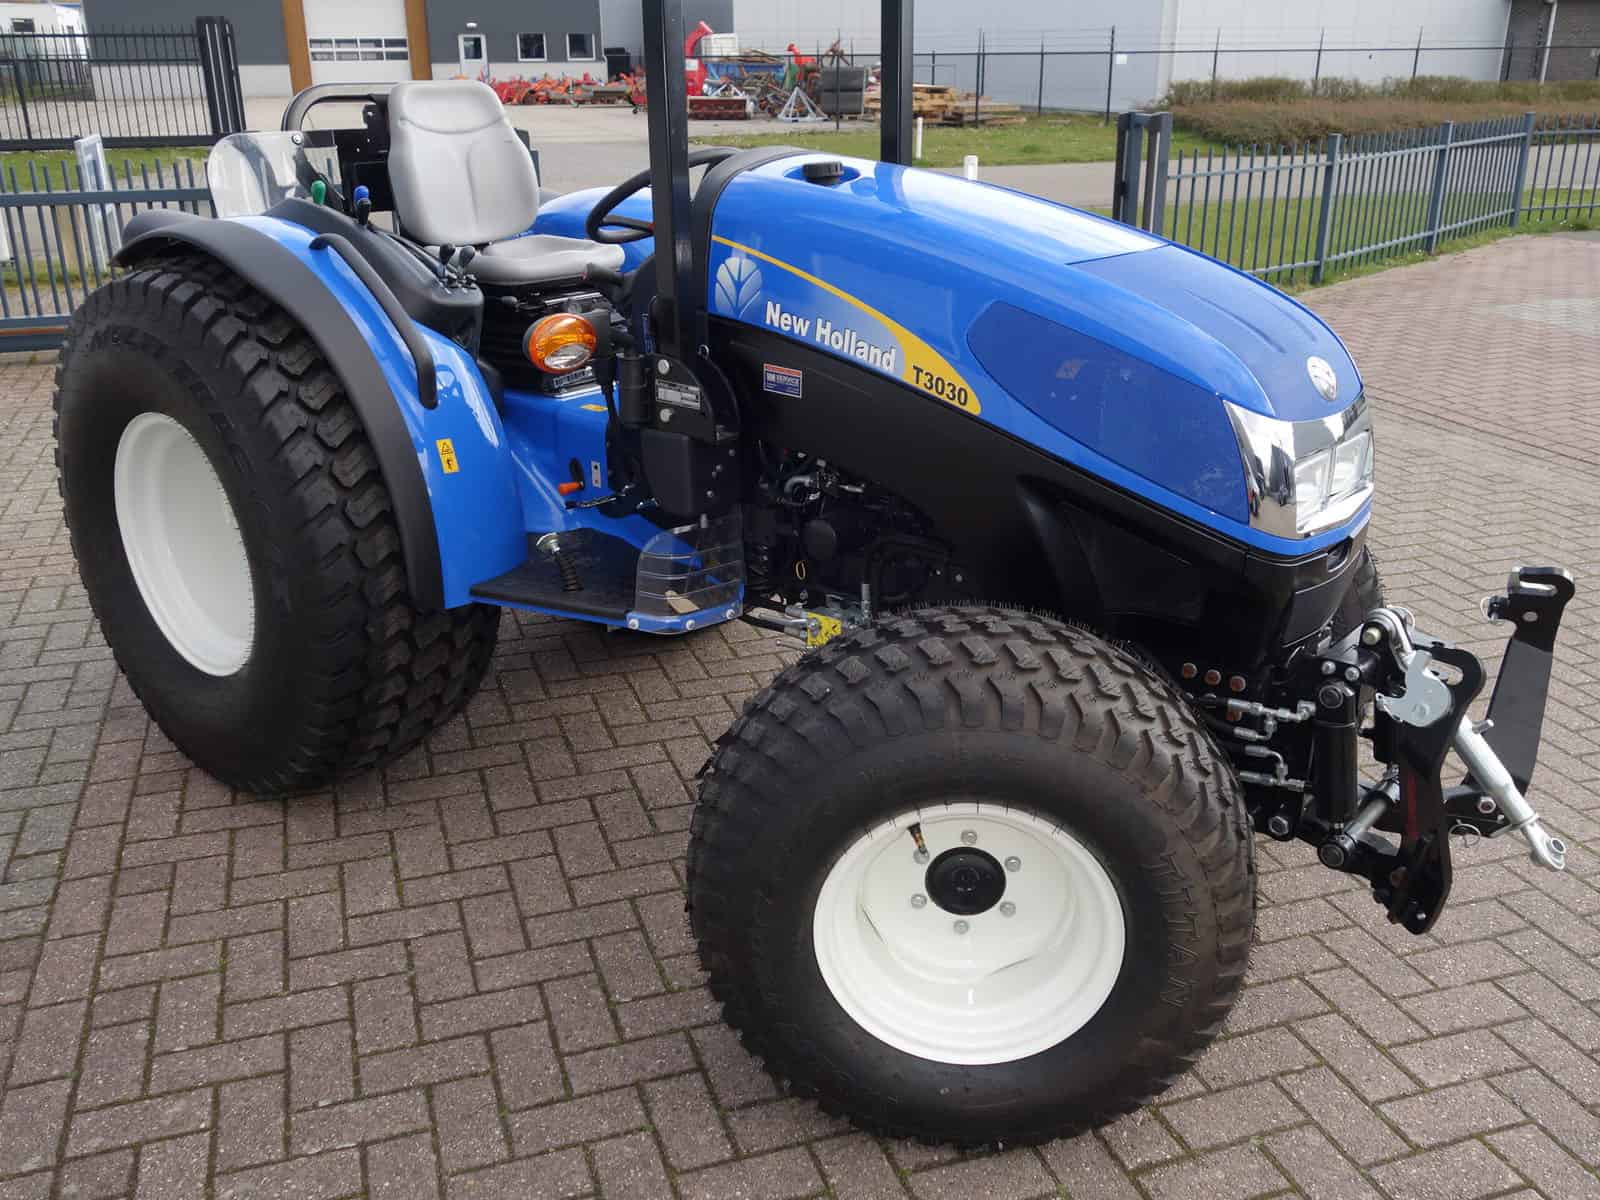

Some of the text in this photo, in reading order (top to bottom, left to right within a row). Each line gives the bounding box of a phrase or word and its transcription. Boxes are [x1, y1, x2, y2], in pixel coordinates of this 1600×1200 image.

[765, 300, 897, 372] New Holland
[912, 365, 968, 407] T3030
[1140, 850, 1201, 1008] TITAN
